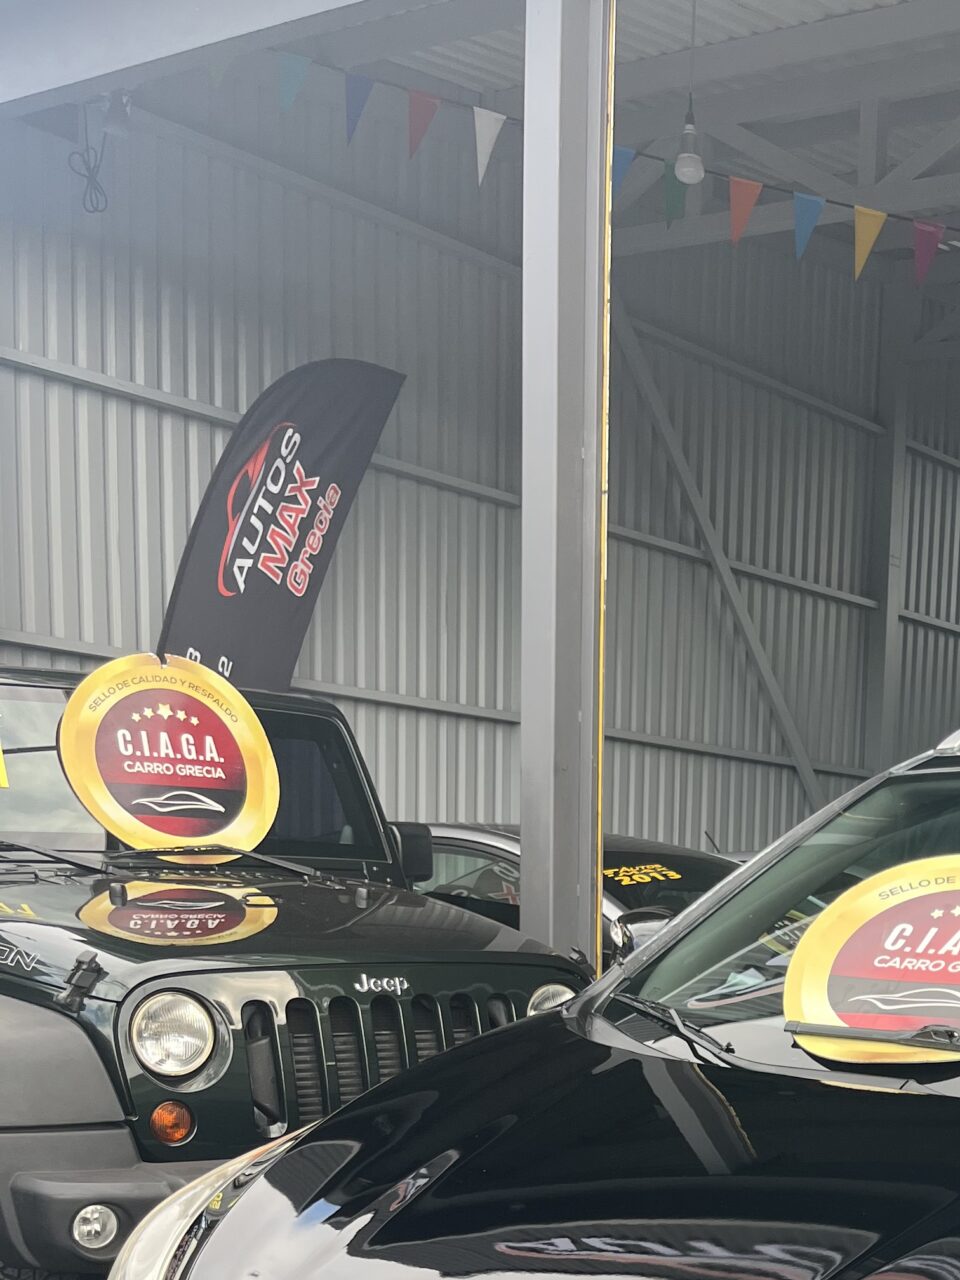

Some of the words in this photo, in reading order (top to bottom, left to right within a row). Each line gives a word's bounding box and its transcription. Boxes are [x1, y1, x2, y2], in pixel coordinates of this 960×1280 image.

[232, 428, 301, 594] AUTOS
[257, 460, 320, 584] MAX
[287, 482, 341, 597] Grecia
[88, 687, 116, 712] SELLO
[116, 680, 131, 691] DE
[131, 674, 177, 685] CALIDAD
[188, 682, 239, 723] RESPALDO
[117, 729, 225, 763] C.I.A.G.A.
[124, 761, 174, 775] CARRO
[176, 764, 226, 780] GRECIA
[614, 871, 682, 886] 2013
[878, 878, 931, 900] SELLO
[934, 875, 956, 885] DE
[873, 955, 945, 972] CARRO
[353, 973, 409, 996] Jeep
